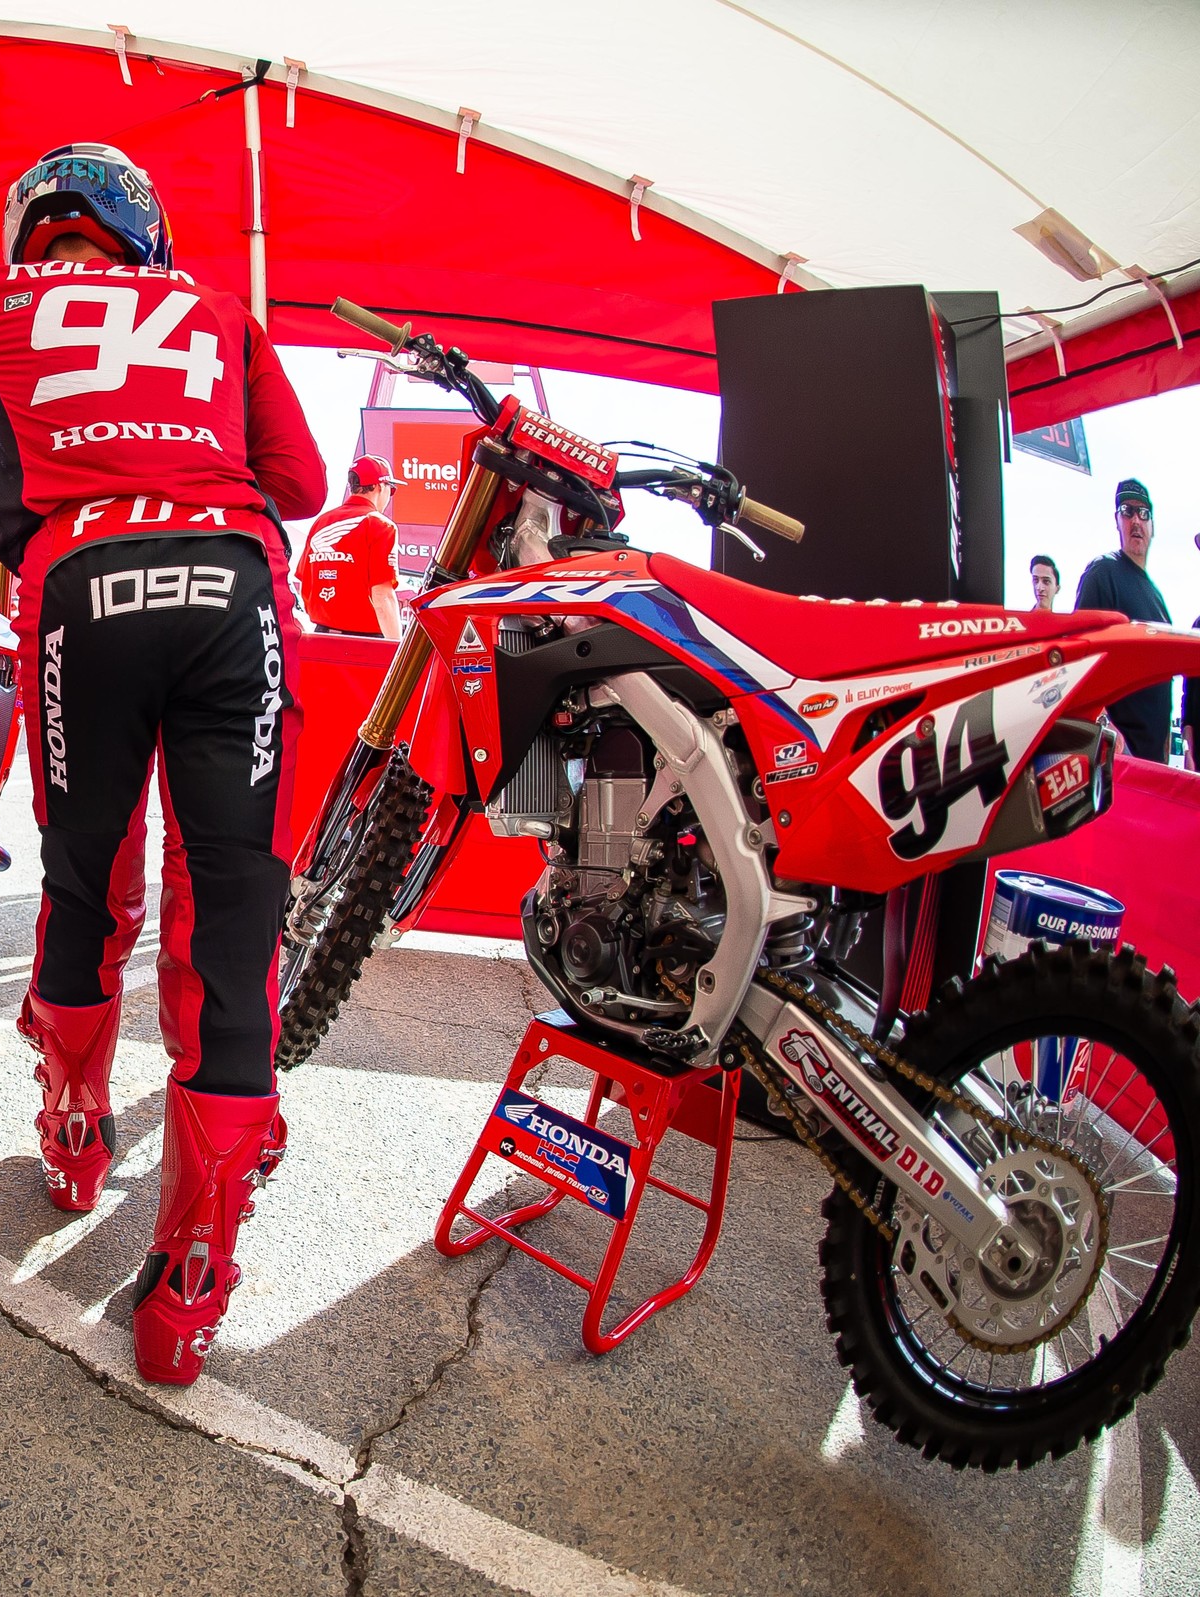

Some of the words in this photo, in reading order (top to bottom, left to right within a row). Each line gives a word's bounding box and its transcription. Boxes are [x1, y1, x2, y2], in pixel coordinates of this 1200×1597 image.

[30, 285, 224, 406] 94
[50, 422, 224, 451] HONDA
[520, 421, 609, 474] RENTHAL
[525, 411, 613, 460] RENTHAL
[424, 482, 448, 491] SKIN
[71, 495, 228, 538] FOX
[308, 551, 355, 564] HONDA
[543, 570, 638, 578] 450R
[88, 566, 236, 620] 1092
[427, 579, 664, 610] CRF
[918, 616, 1027, 640] HONDA
[452, 656, 492, 675] HRC
[963, 645, 1042, 669] ROCZEN
[250, 604, 284, 786] HONDA
[883, 682, 913, 695] Power
[44, 625, 69, 794] HONDA
[802, 702, 822, 713] Twin
[822, 698, 837, 710] Air
[878, 688, 1010, 860] 94
[1038, 913, 1067, 931] OUR
[1068, 921, 1112, 939] PASSION
[527, 1113, 627, 1177] HONDA
[536, 1138, 580, 1174] HRC
